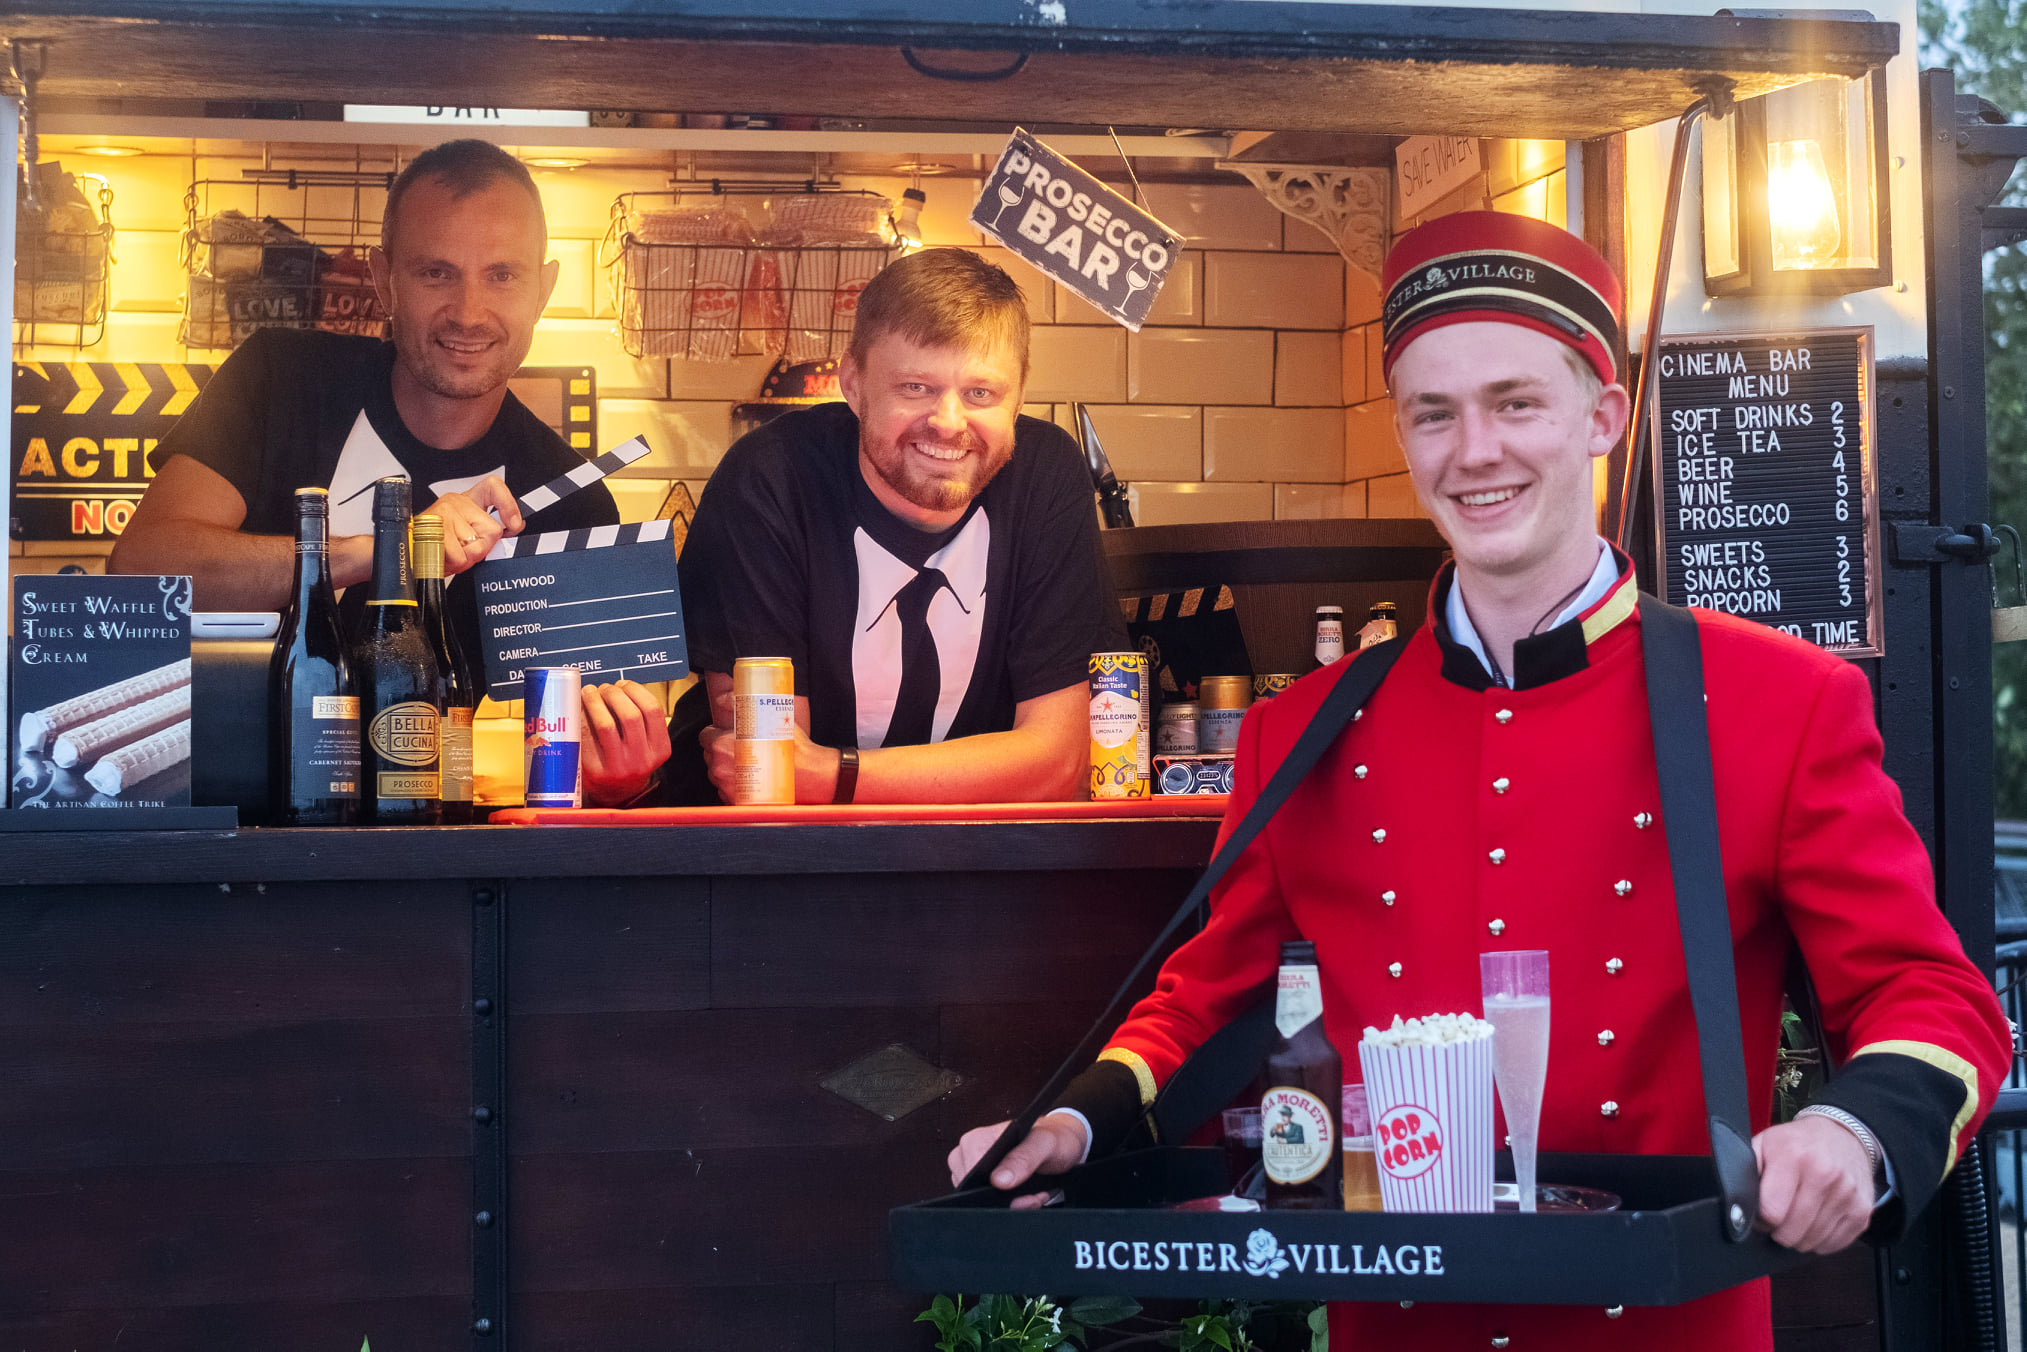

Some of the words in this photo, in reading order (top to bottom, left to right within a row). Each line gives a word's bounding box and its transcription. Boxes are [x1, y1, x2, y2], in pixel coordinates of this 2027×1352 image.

[1403, 147, 1432, 197] SAVE
[1003, 149, 1168, 272] PROSECCO
[1017, 199, 1121, 291] BAR
[1448, 264, 1536, 284] VILLAGE
[1660, 351, 1747, 377] CINEMA
[1769, 349, 1811, 372] BAR
[1728, 374, 1789, 399] MENU
[1671, 408, 1721, 432] SOFT
[1735, 403, 1813, 429] DRINKS
[1830, 401, 1844, 425] 2
[1677, 433, 1717, 457] ICE
[1737, 430, 1781, 454] TEA
[1833, 426, 1846, 448] 3
[1678, 457, 1734, 482] BEER
[1832, 450, 1845, 473] 4
[1678, 482, 1733, 507] WINE
[1836, 475, 1849, 498] 5
[1679, 503, 1790, 530] PROSECCO
[1835, 499, 1849, 522] 6
[1680, 541, 1765, 567] SWEETS
[1836, 535, 1849, 558] 3
[481, 575, 555, 593] HOLLYWOOD
[1684, 565, 1771, 592] SNACKS
[1838, 560, 1851, 584] 2
[484, 599, 548, 616] PRODUCTION
[1838, 584, 1852, 607] 3
[83, 624, 95, 639] &
[493, 623, 542, 638] DIRECTOR
[1811, 620, 1860, 645] TIME
[499, 647, 539, 661] CAMERA
[509, 670, 525, 681] DA
[637, 652, 668, 664] TAKE
[394, 718, 433, 731] BELLA
[536, 717, 566, 732] Bull
[394, 737, 432, 748] CUCINA
[393, 780, 434, 788] PROSECCO
[1277, 1094, 1328, 1142] MORETTI
[1377, 1113, 1421, 1146] POP
[1383, 1131, 1441, 1170] CORN
[1074, 1241, 1242, 1272] BICESTER
[1288, 1244, 1444, 1275] VILLAGE
